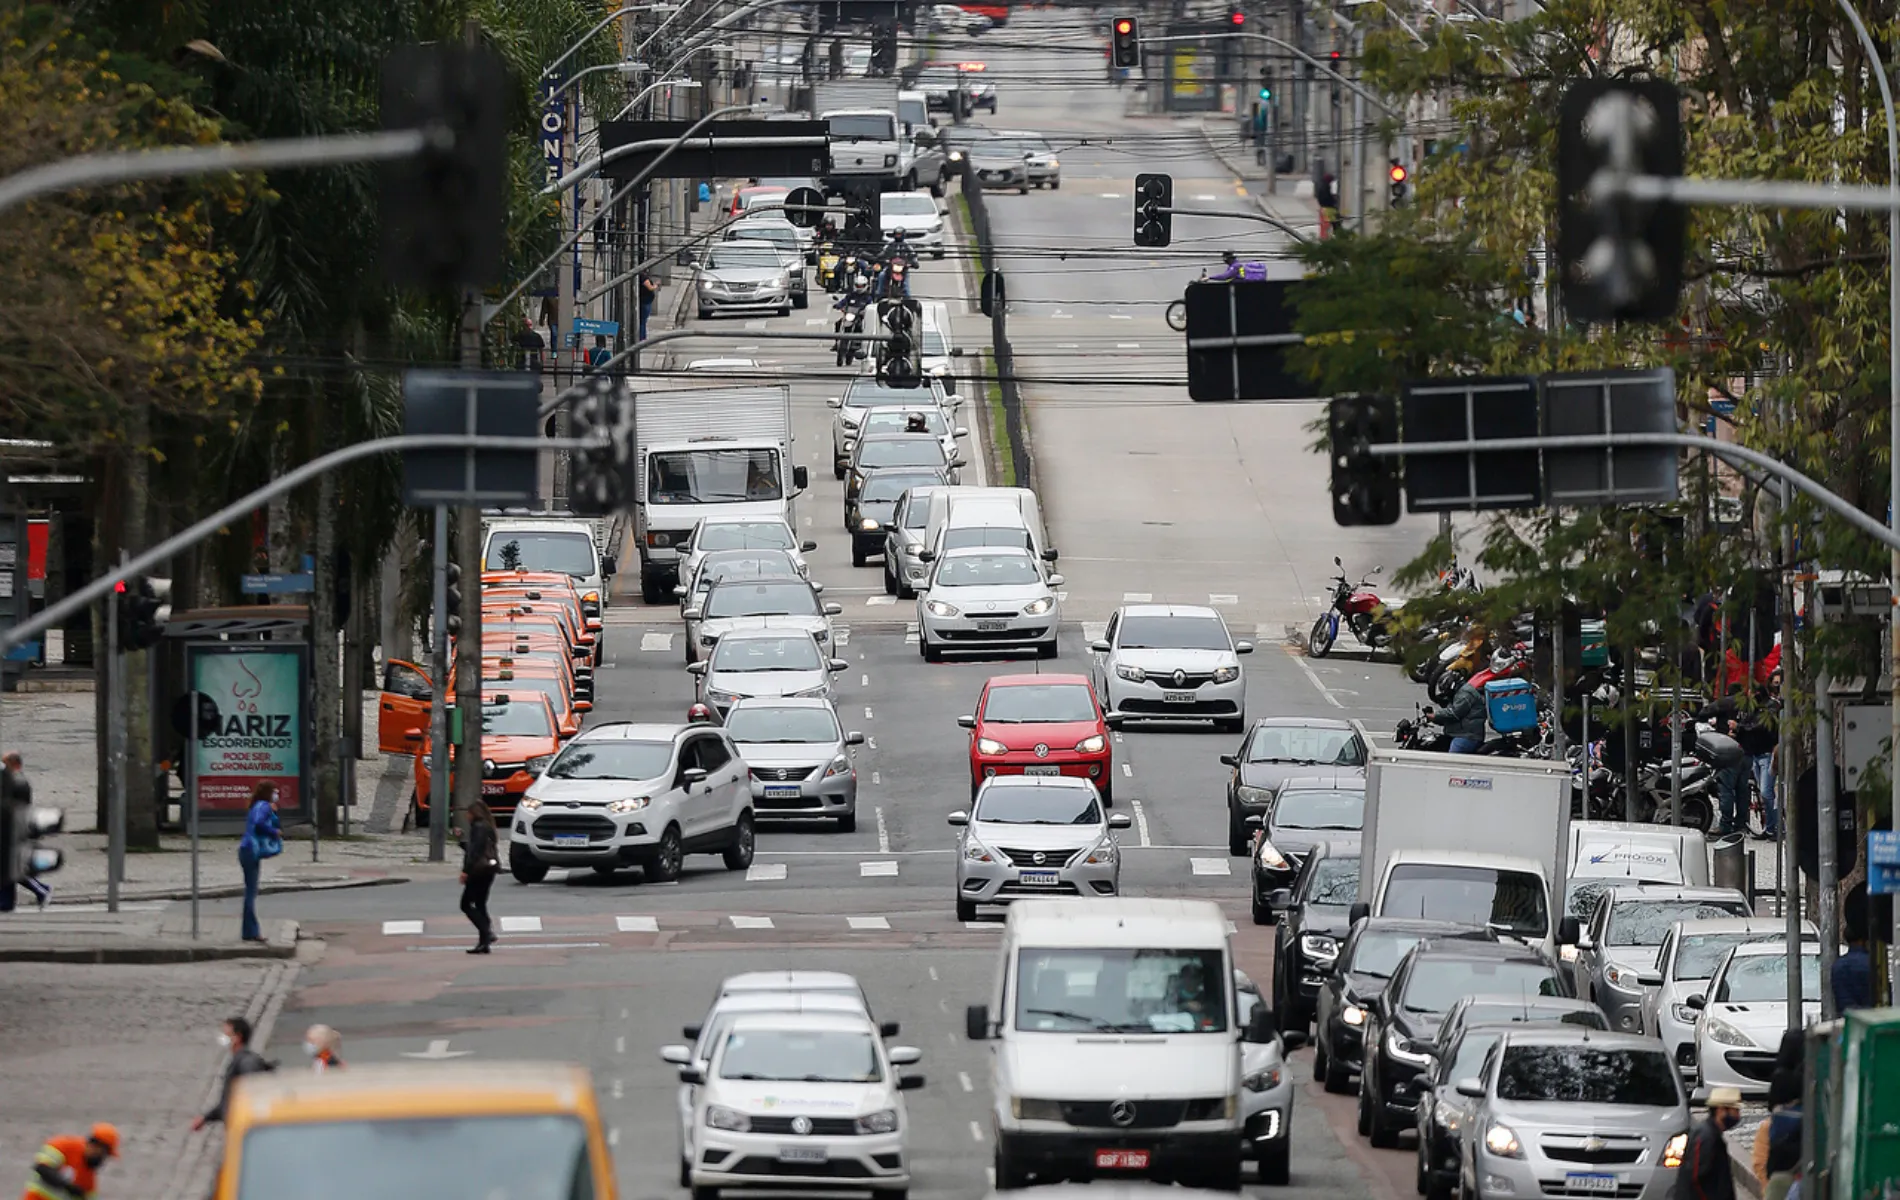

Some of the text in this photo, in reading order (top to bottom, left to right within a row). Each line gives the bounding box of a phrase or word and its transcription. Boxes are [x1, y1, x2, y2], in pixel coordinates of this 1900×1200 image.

[203, 738, 292, 749] ESCORRENDO?
[223, 752, 271, 761] PODE SER
